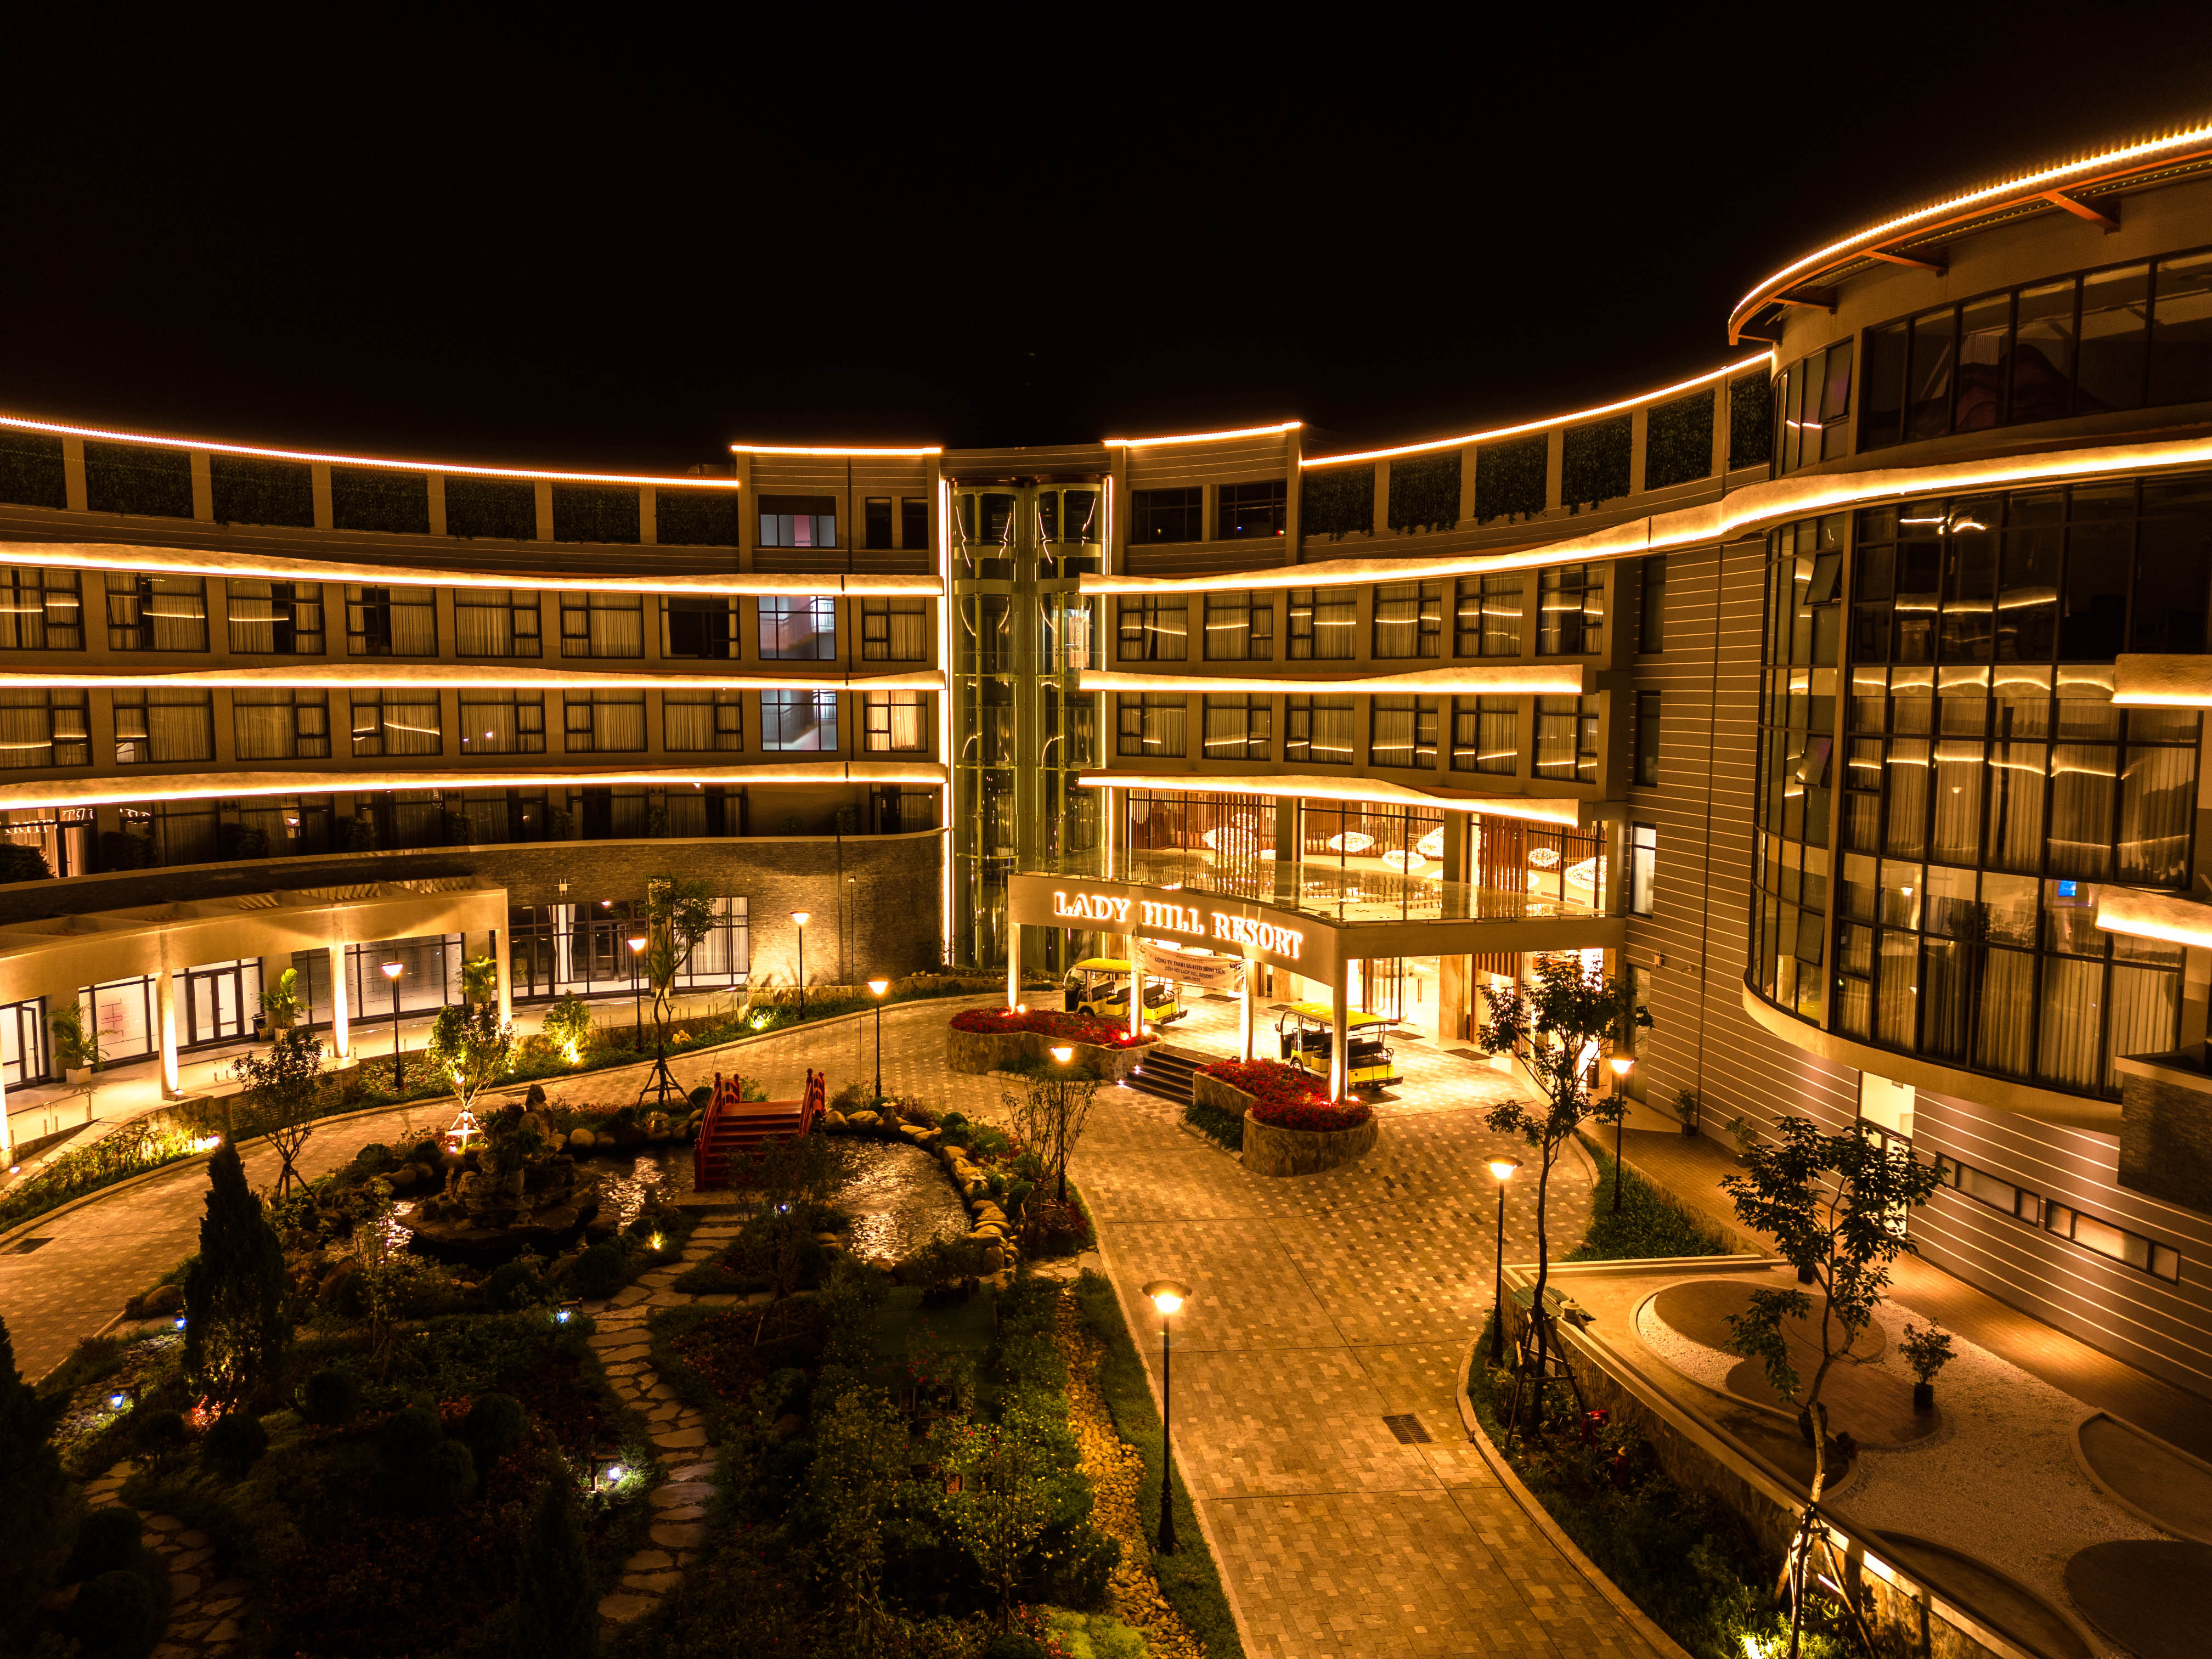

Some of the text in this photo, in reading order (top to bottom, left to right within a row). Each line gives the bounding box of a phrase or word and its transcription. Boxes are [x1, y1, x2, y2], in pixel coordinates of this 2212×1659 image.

[1053, 892, 1303, 958] LADY HILL RESORT
